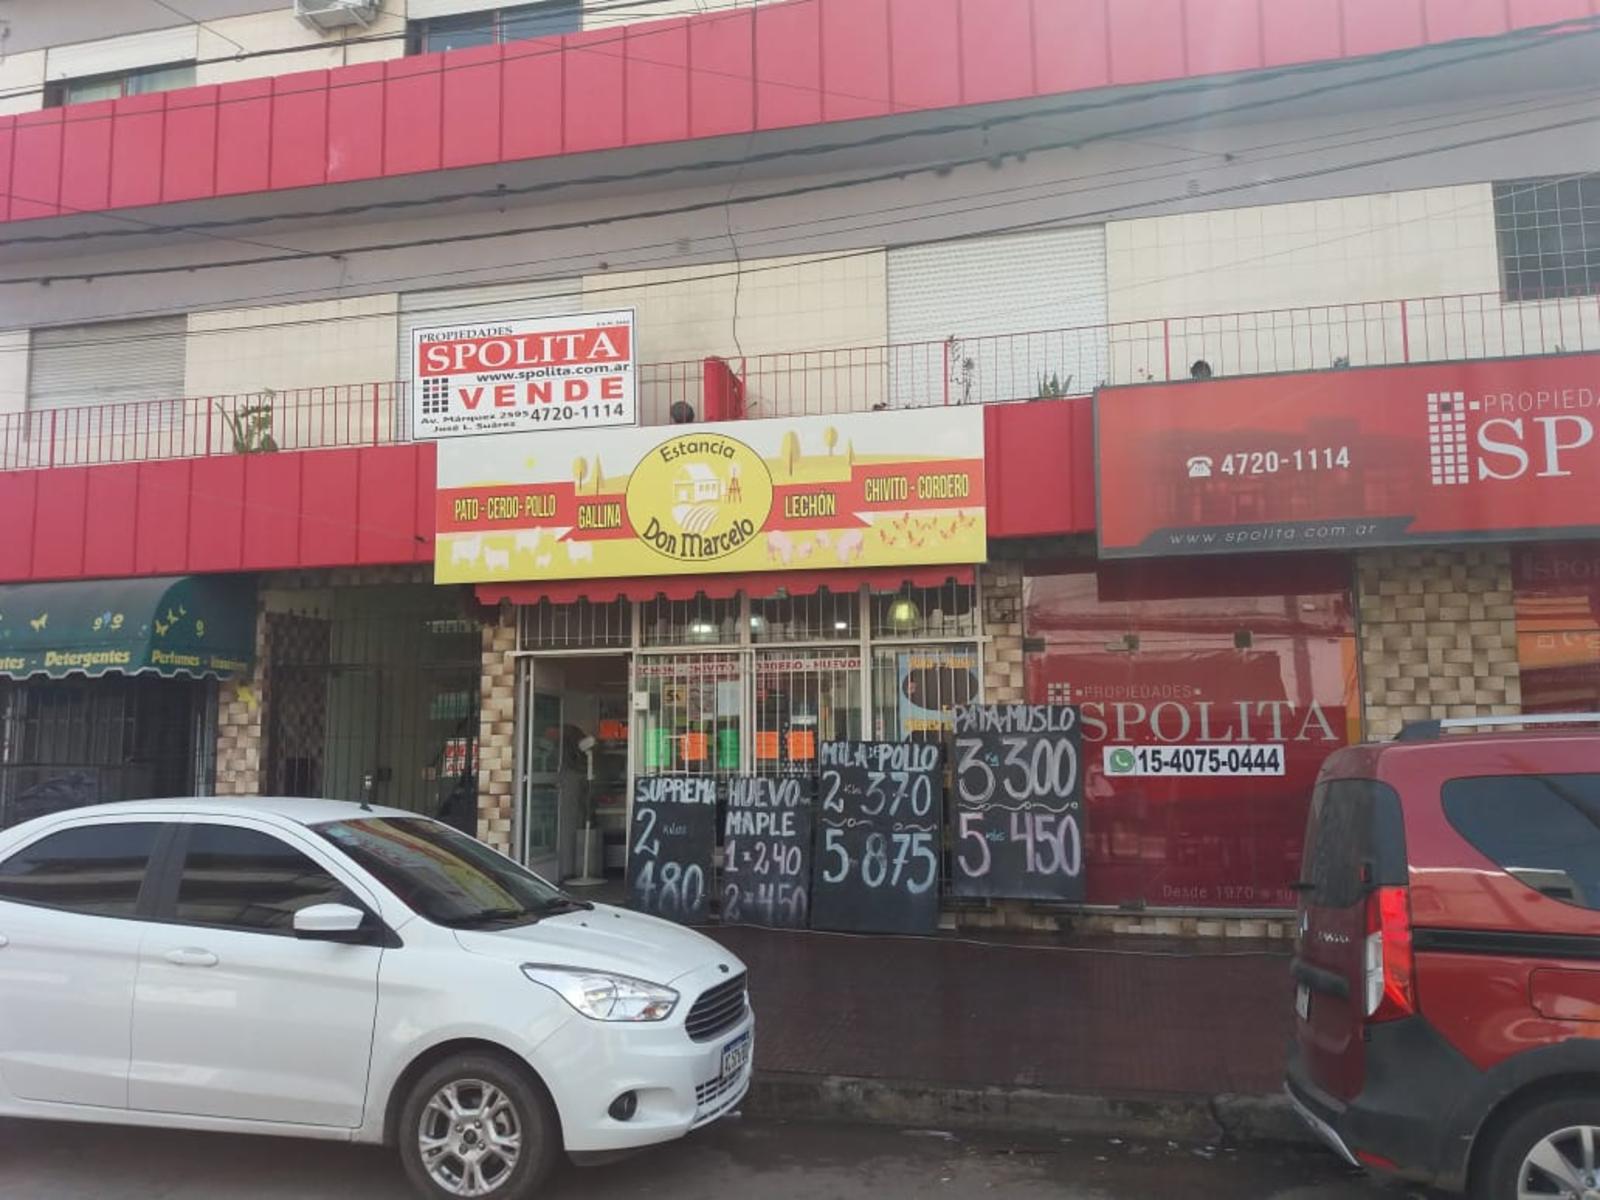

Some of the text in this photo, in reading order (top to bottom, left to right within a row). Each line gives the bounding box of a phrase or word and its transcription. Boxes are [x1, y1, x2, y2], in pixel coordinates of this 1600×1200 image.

[419, 326, 513, 343] PROPIEDADES
[427, 331, 620, 372] SPOLITA
[476, 363, 630, 382] www.spolita.com.ar
[458, 376, 624, 410] VENDE
[1484, 388, 1600, 413] PROPIED
[531, 402, 624, 422] 4720-1114
[660, 440, 736, 463] Estancia
[1220, 446, 1350, 475] 4720-1114
[864, 473, 969, 502] CHIVITO CORDERO
[454, 494, 556, 521] PATO CERDO POLLO
[578, 503, 622, 529] GALLINA
[784, 488, 836, 518] LECHÓN
[643, 516, 754, 557] Don Marcelo
[44, 649, 131, 668] Detergentes
[1084, 684, 1193, 699] PROPIEDADES
[953, 704, 1002, 733] PATA
[1006, 704, 1076, 732] MUSLO
[1080, 699, 1340, 742] SPOLITA
[821, 741, 868, 769] MILA
[879, 743, 939, 772] POLLO
[956, 738, 996, 803] 3
[1002, 737, 1077, 799] 300
[1138, 748, 1280, 773] 15-4075-0444
[636, 777, 717, 804] SUPREMA
[728, 778, 801, 807] HUEVO
[823, 770, 844, 813] 2
[861, 771, 932, 816] 370
[634, 808, 660, 857] 2
[725, 811, 796, 837] MAPLE
[958, 811, 991, 877] 5
[1010, 812, 1082, 877] 450
[823, 829, 938, 894] 5 875
[635, 860, 704, 914] 480
